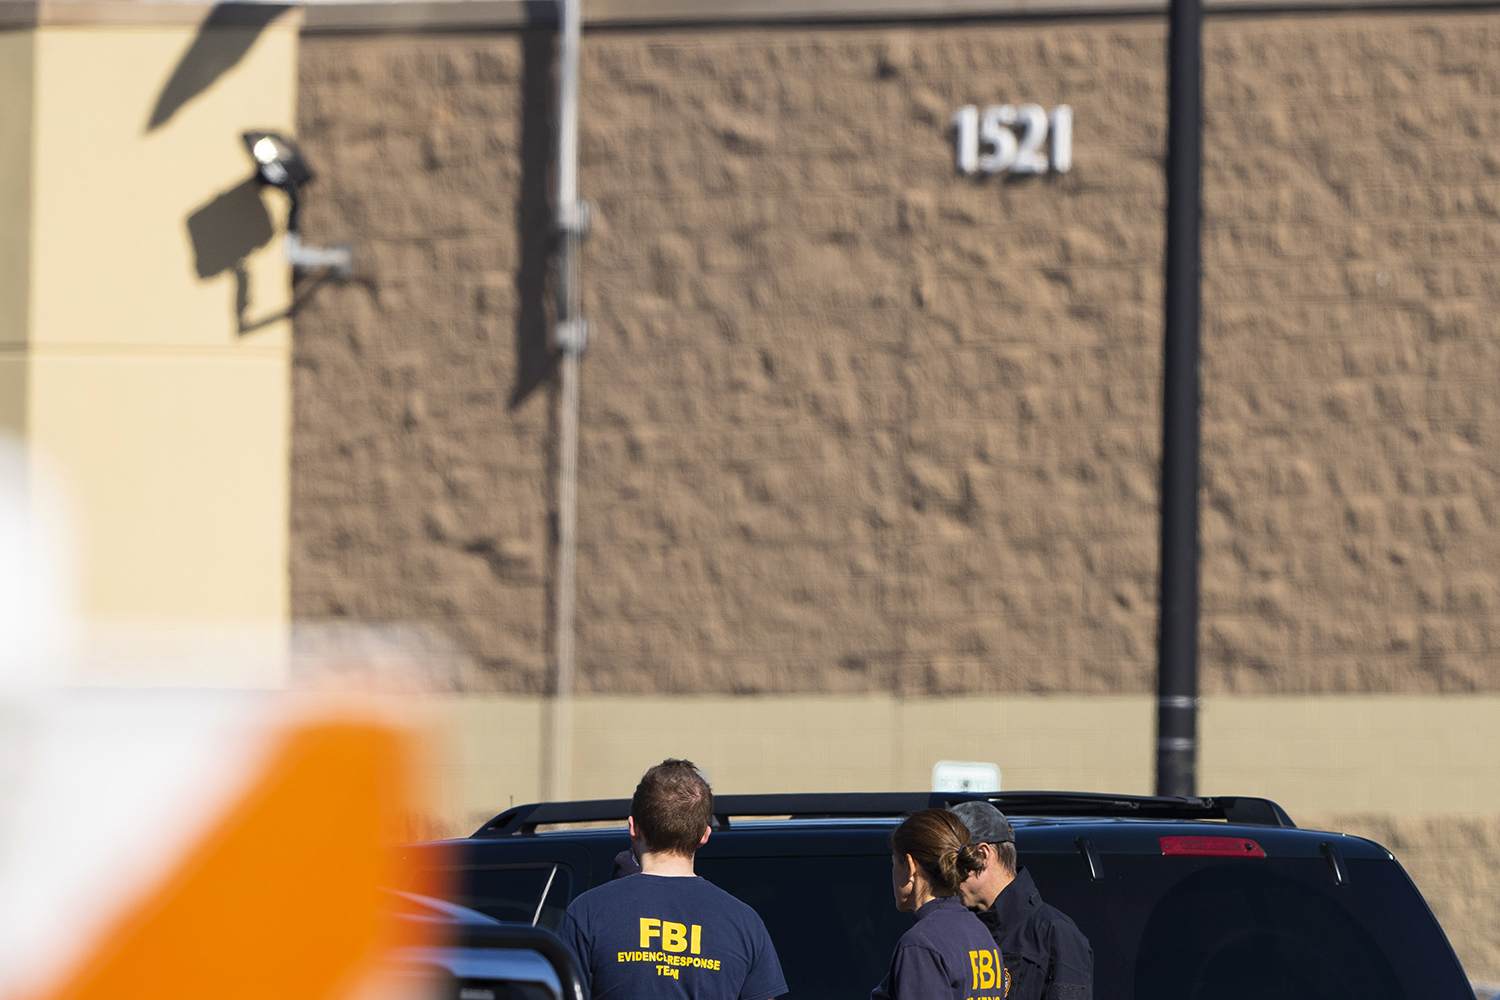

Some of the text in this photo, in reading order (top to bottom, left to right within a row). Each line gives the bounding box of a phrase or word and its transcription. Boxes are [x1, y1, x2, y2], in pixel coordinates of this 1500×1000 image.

[950, 103, 1073, 173] 1521
[640, 917, 702, 954] FBI
[666, 955, 721, 970] RESPONSE
[968, 949, 1002, 989] FBI
